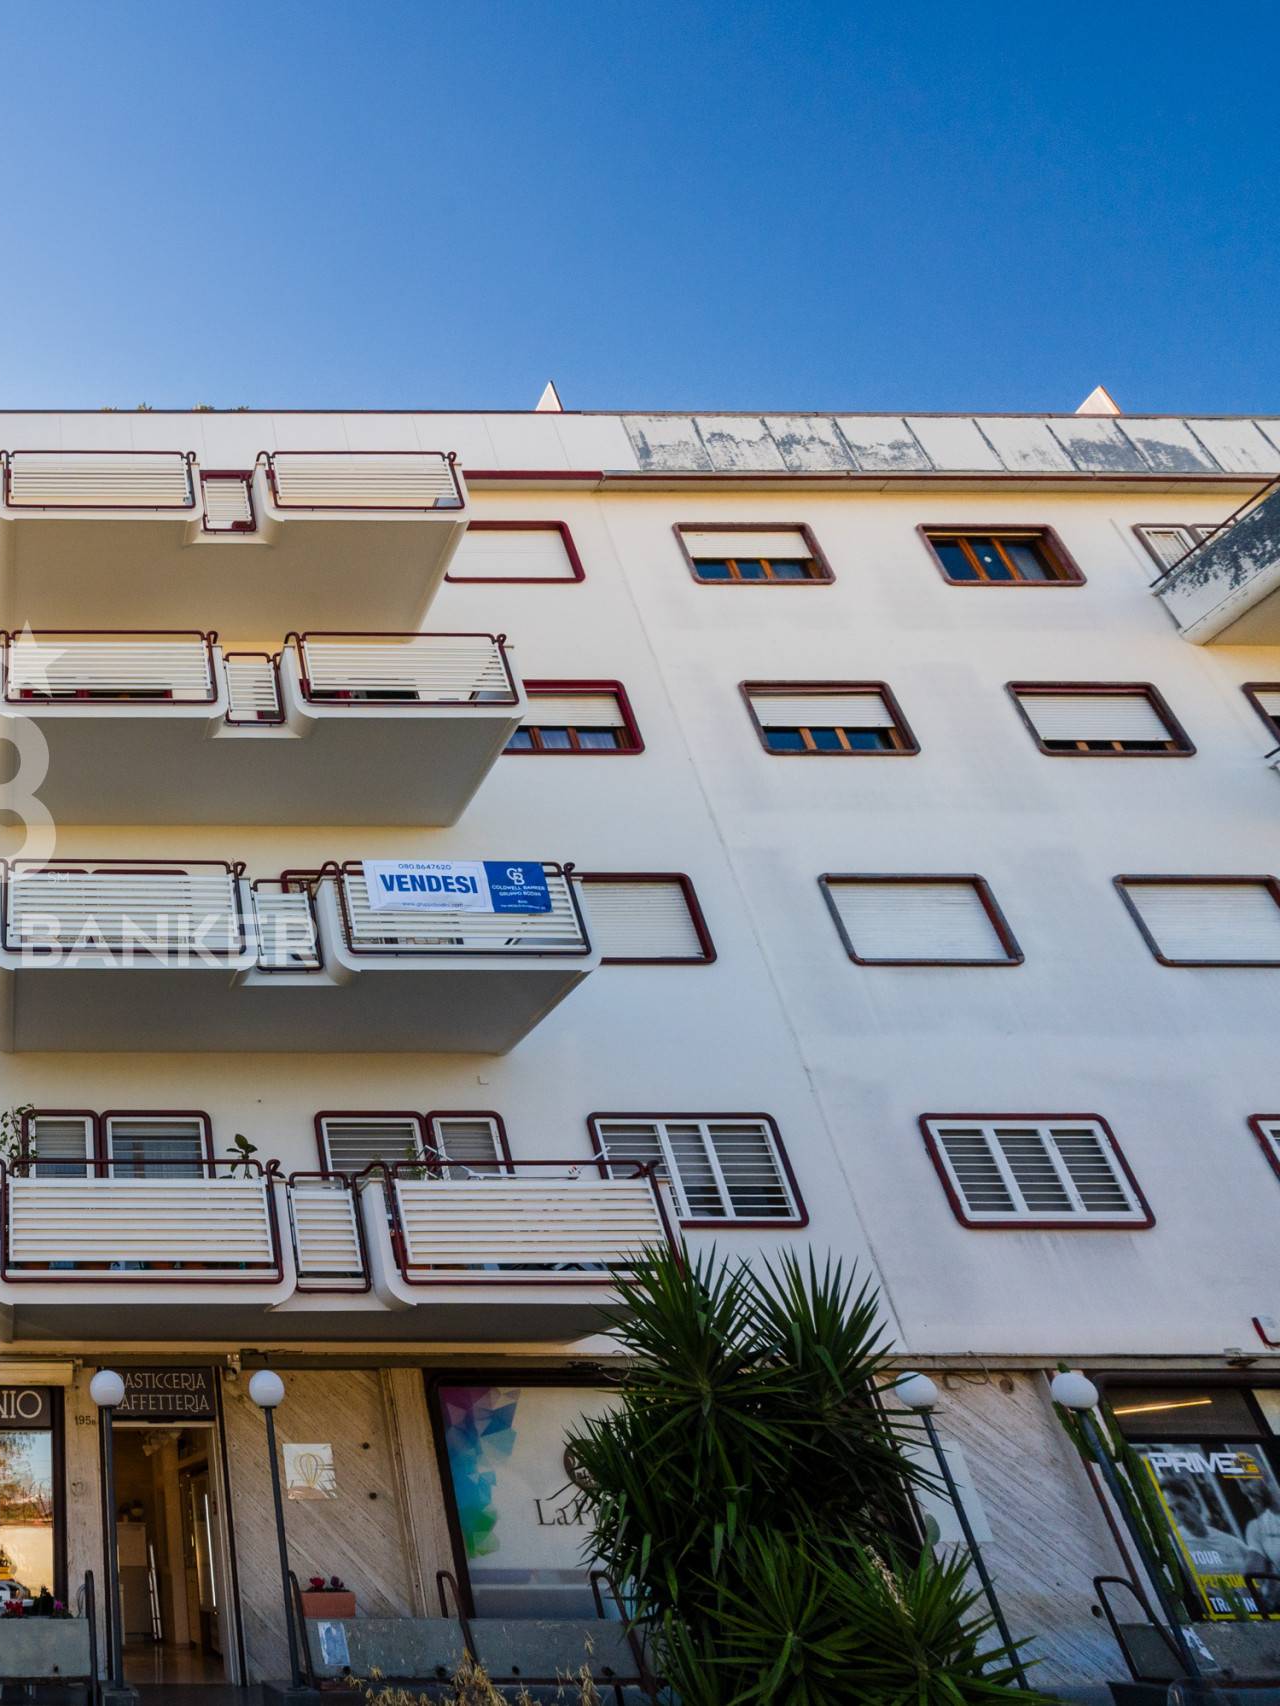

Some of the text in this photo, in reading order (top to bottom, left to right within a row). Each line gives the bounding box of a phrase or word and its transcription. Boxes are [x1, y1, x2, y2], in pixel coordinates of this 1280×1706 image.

[380, 873, 479, 894] VENDESI
[116, 1394, 210, 1413] AFFETTERIA
[1147, 1452, 1244, 1479] PRIME
[1189, 1550, 1223, 1566] YOUR
